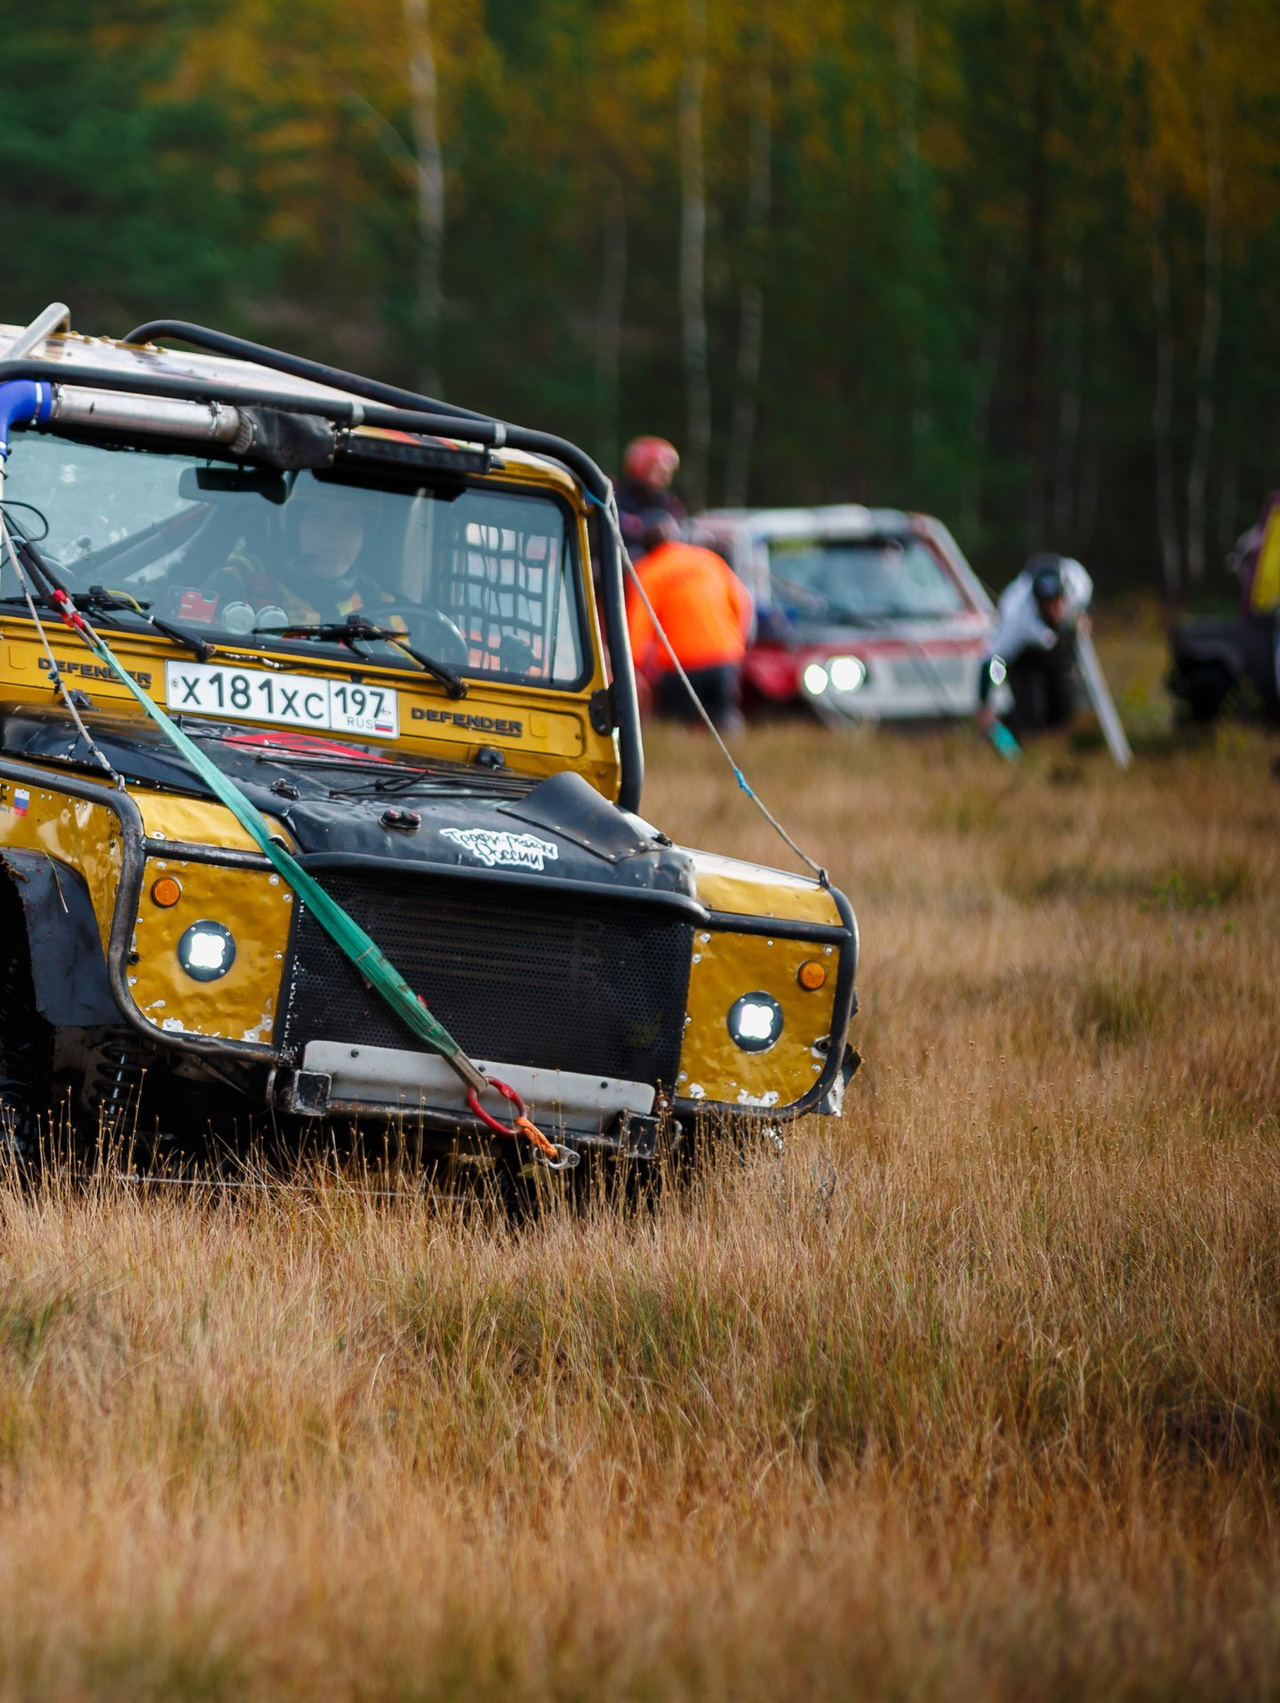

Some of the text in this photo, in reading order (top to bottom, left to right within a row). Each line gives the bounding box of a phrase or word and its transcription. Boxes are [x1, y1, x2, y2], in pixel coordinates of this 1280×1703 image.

[334, 686, 385, 718] 197
[347, 716, 374, 730] RUS
[411, 707, 524, 733] DEFENDER
